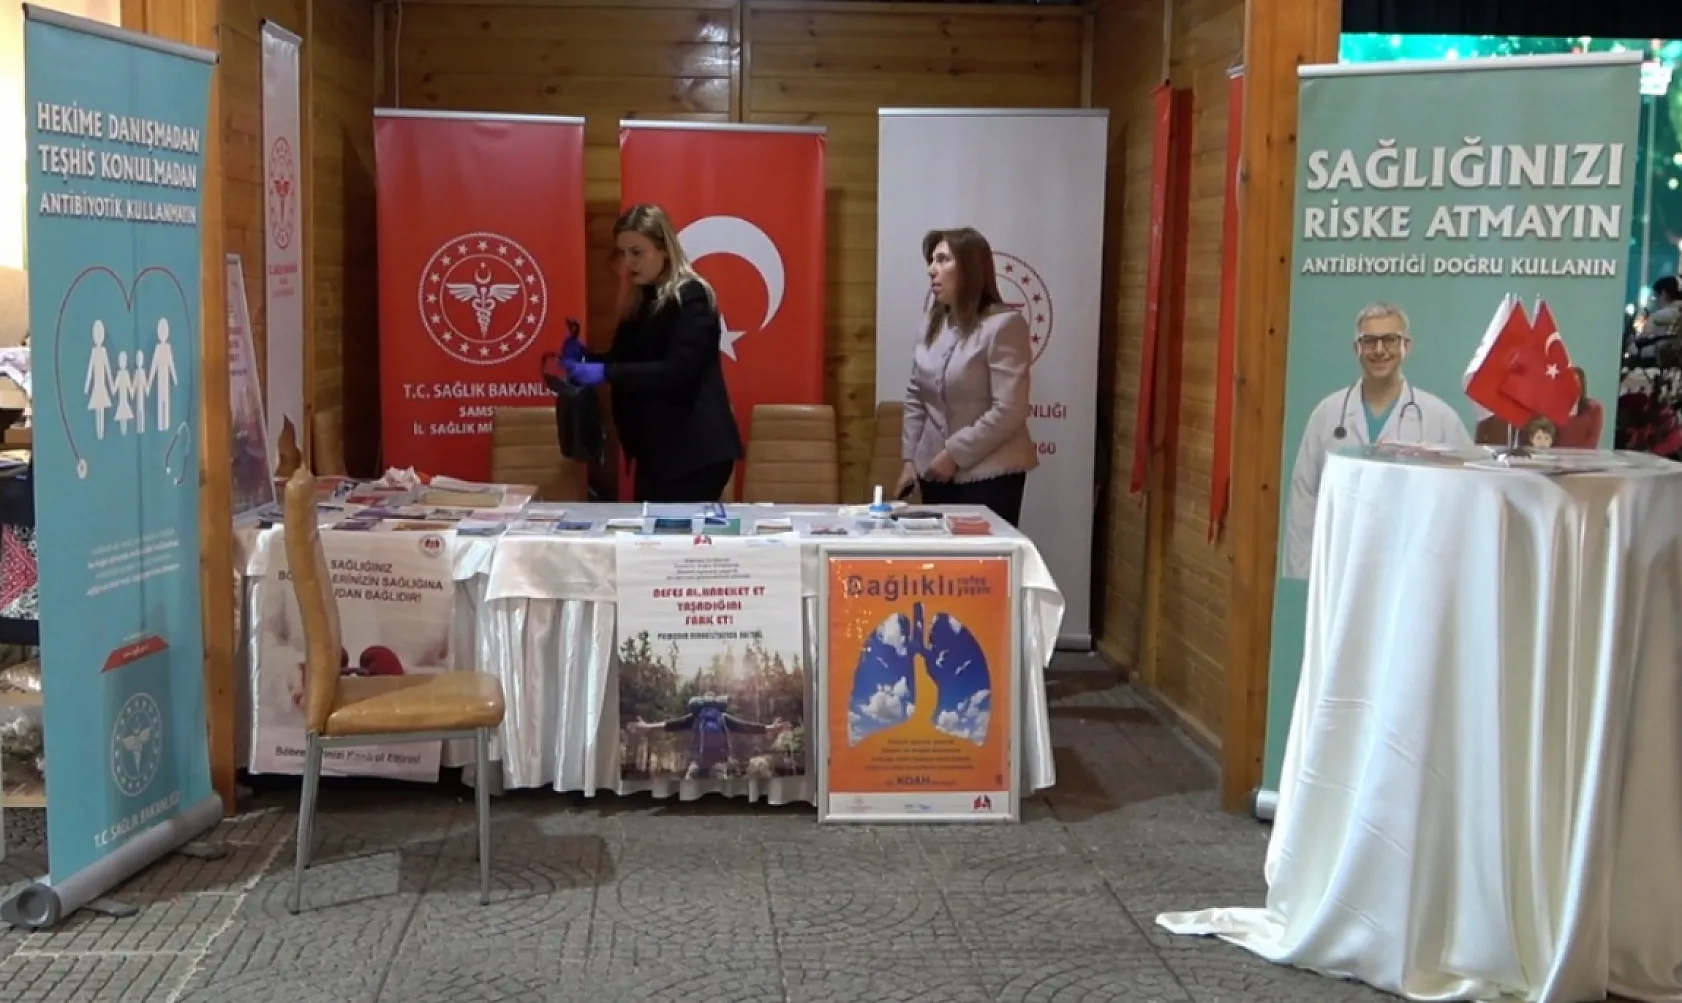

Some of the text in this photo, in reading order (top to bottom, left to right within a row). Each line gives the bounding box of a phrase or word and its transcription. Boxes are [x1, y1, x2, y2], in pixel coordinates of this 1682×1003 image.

[37, 100, 200, 154] HEKİME DANIŞMADAN
[38, 142, 197, 190] TEŞHİS KONULMADAN
[1306, 137, 1624, 190] SAĞLIĞINIZI
[39, 190, 123, 219] ANTİBİYOTİK
[1303, 198, 1622, 239] RİSKE ATMAYIN
[1301, 253, 1617, 277] ANTİBİYOTİĞİ DOĞRU KULLANIN
[403, 383, 430, 399] T.C.
[433, 380, 485, 398] SAĞLIK
[430, 420, 475, 435] SAĞLIK
